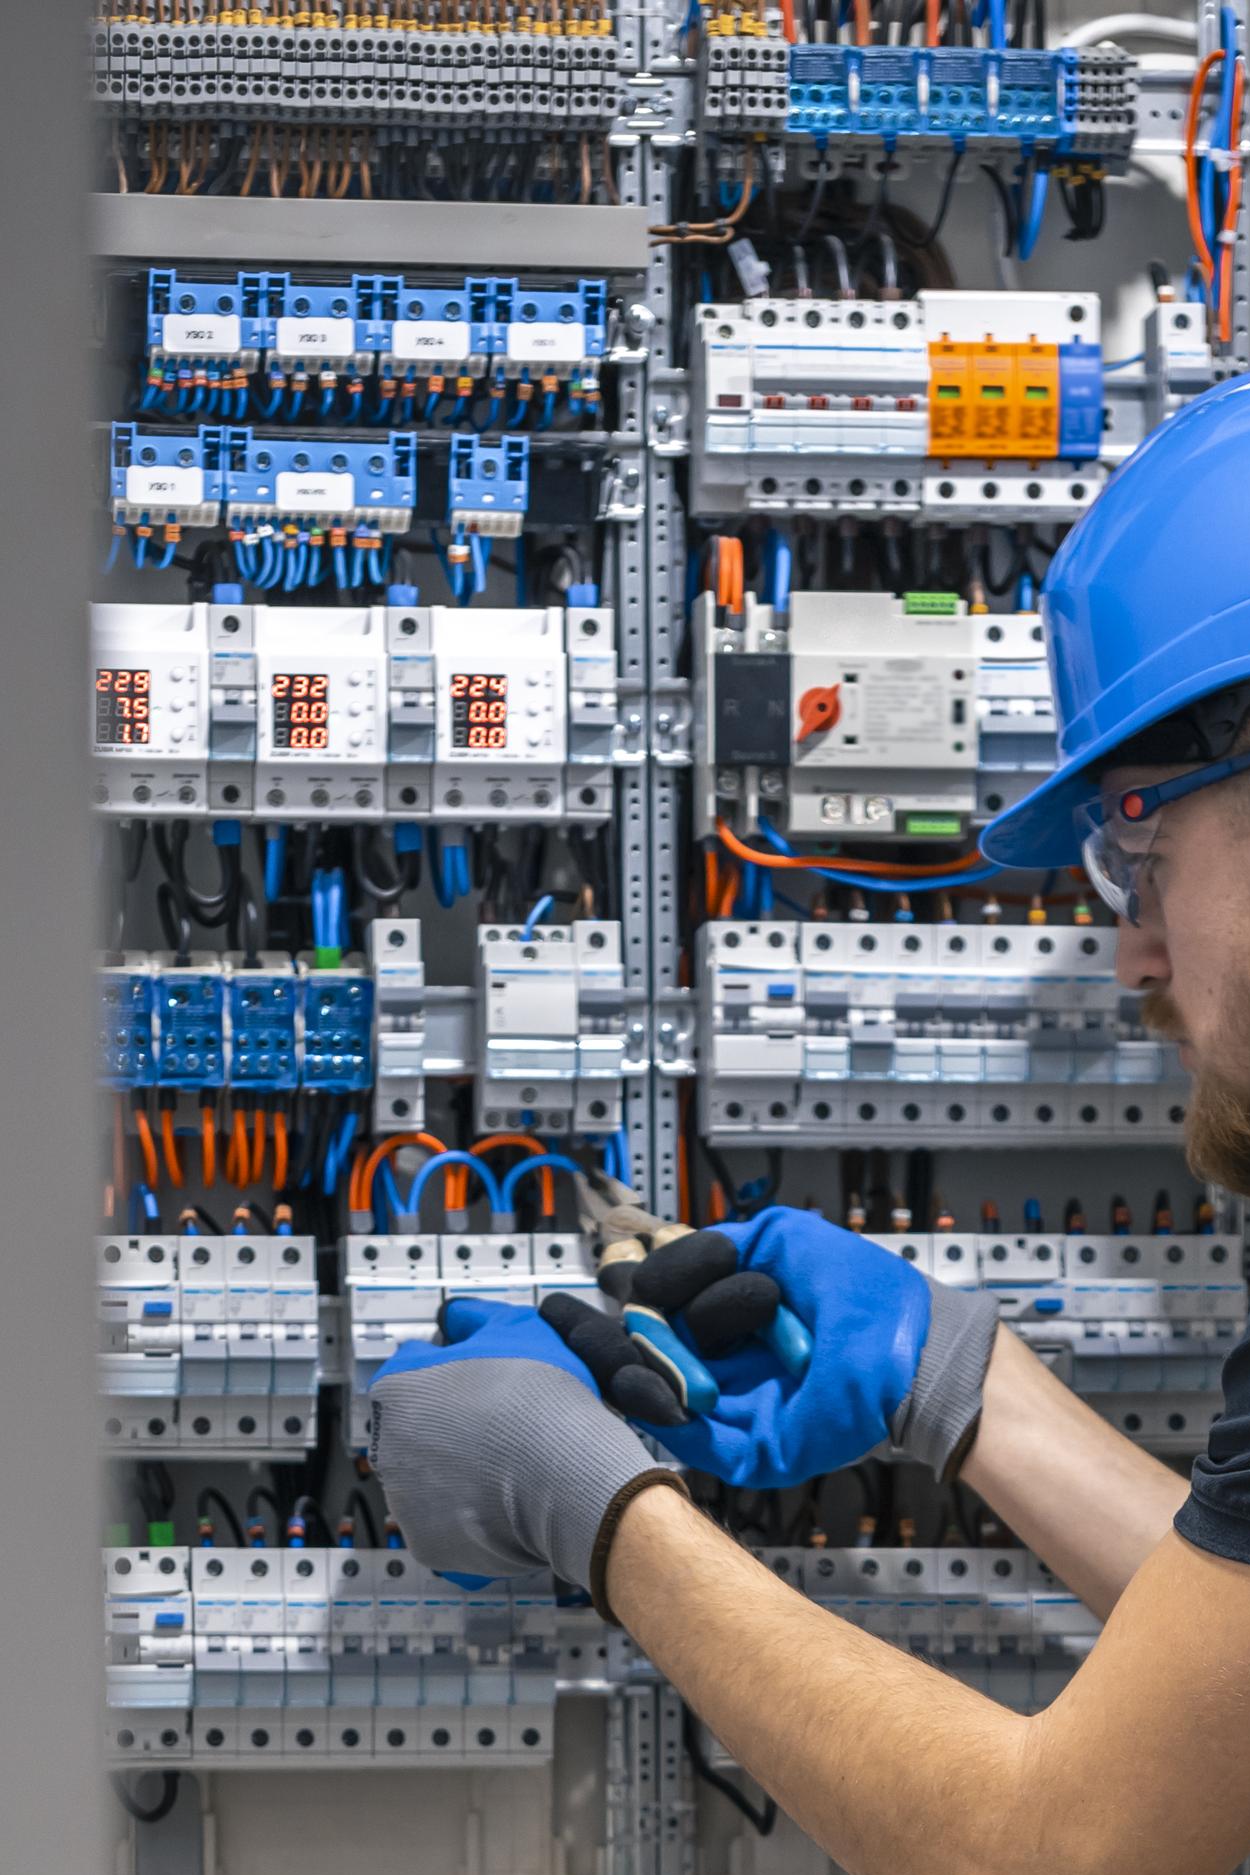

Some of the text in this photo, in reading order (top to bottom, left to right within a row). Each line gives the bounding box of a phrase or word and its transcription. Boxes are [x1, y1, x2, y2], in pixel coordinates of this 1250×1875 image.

[95, 671, 150, 693] 229
[271, 675, 328, 698] 232
[450, 675, 508, 698] 224
